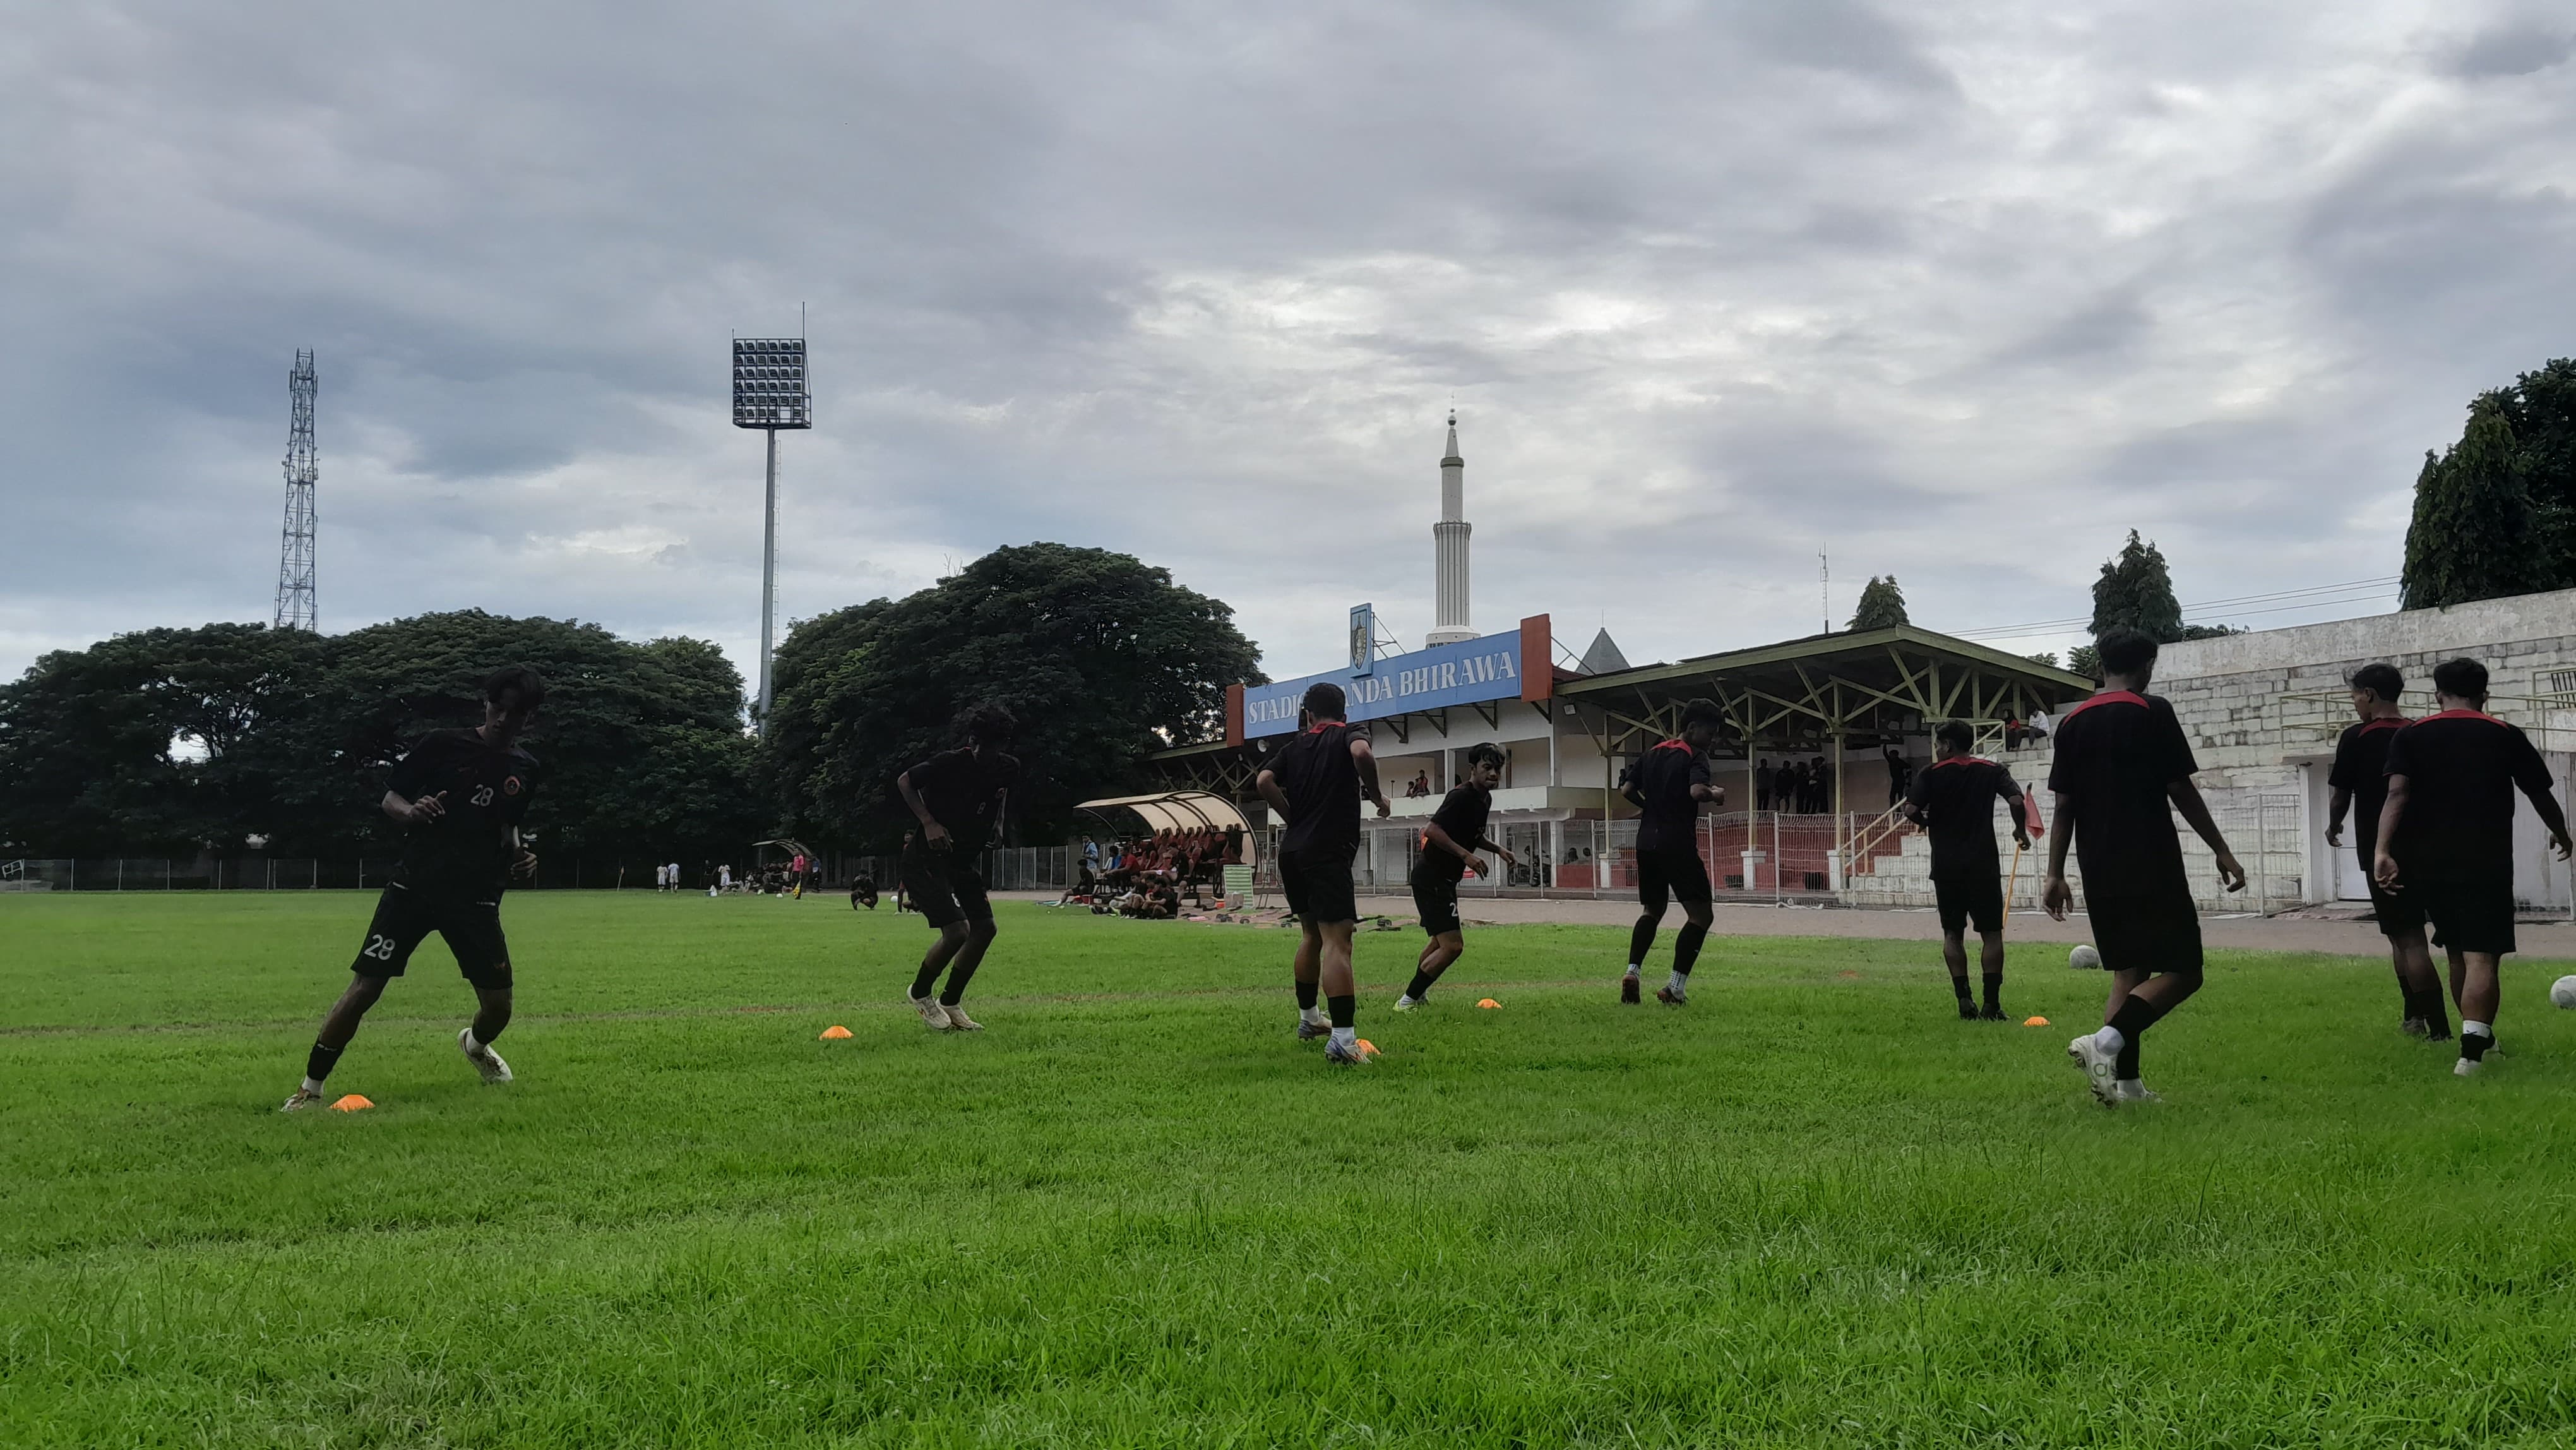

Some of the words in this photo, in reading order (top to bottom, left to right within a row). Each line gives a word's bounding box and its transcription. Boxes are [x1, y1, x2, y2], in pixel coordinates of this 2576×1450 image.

[1249, 692, 1306, 724] STADI
[1339, 676, 1394, 709] ANDA
[1398, 651, 1516, 697] BHIRAWA
[470, 784, 494, 806] 28
[364, 934, 396, 961] 28
